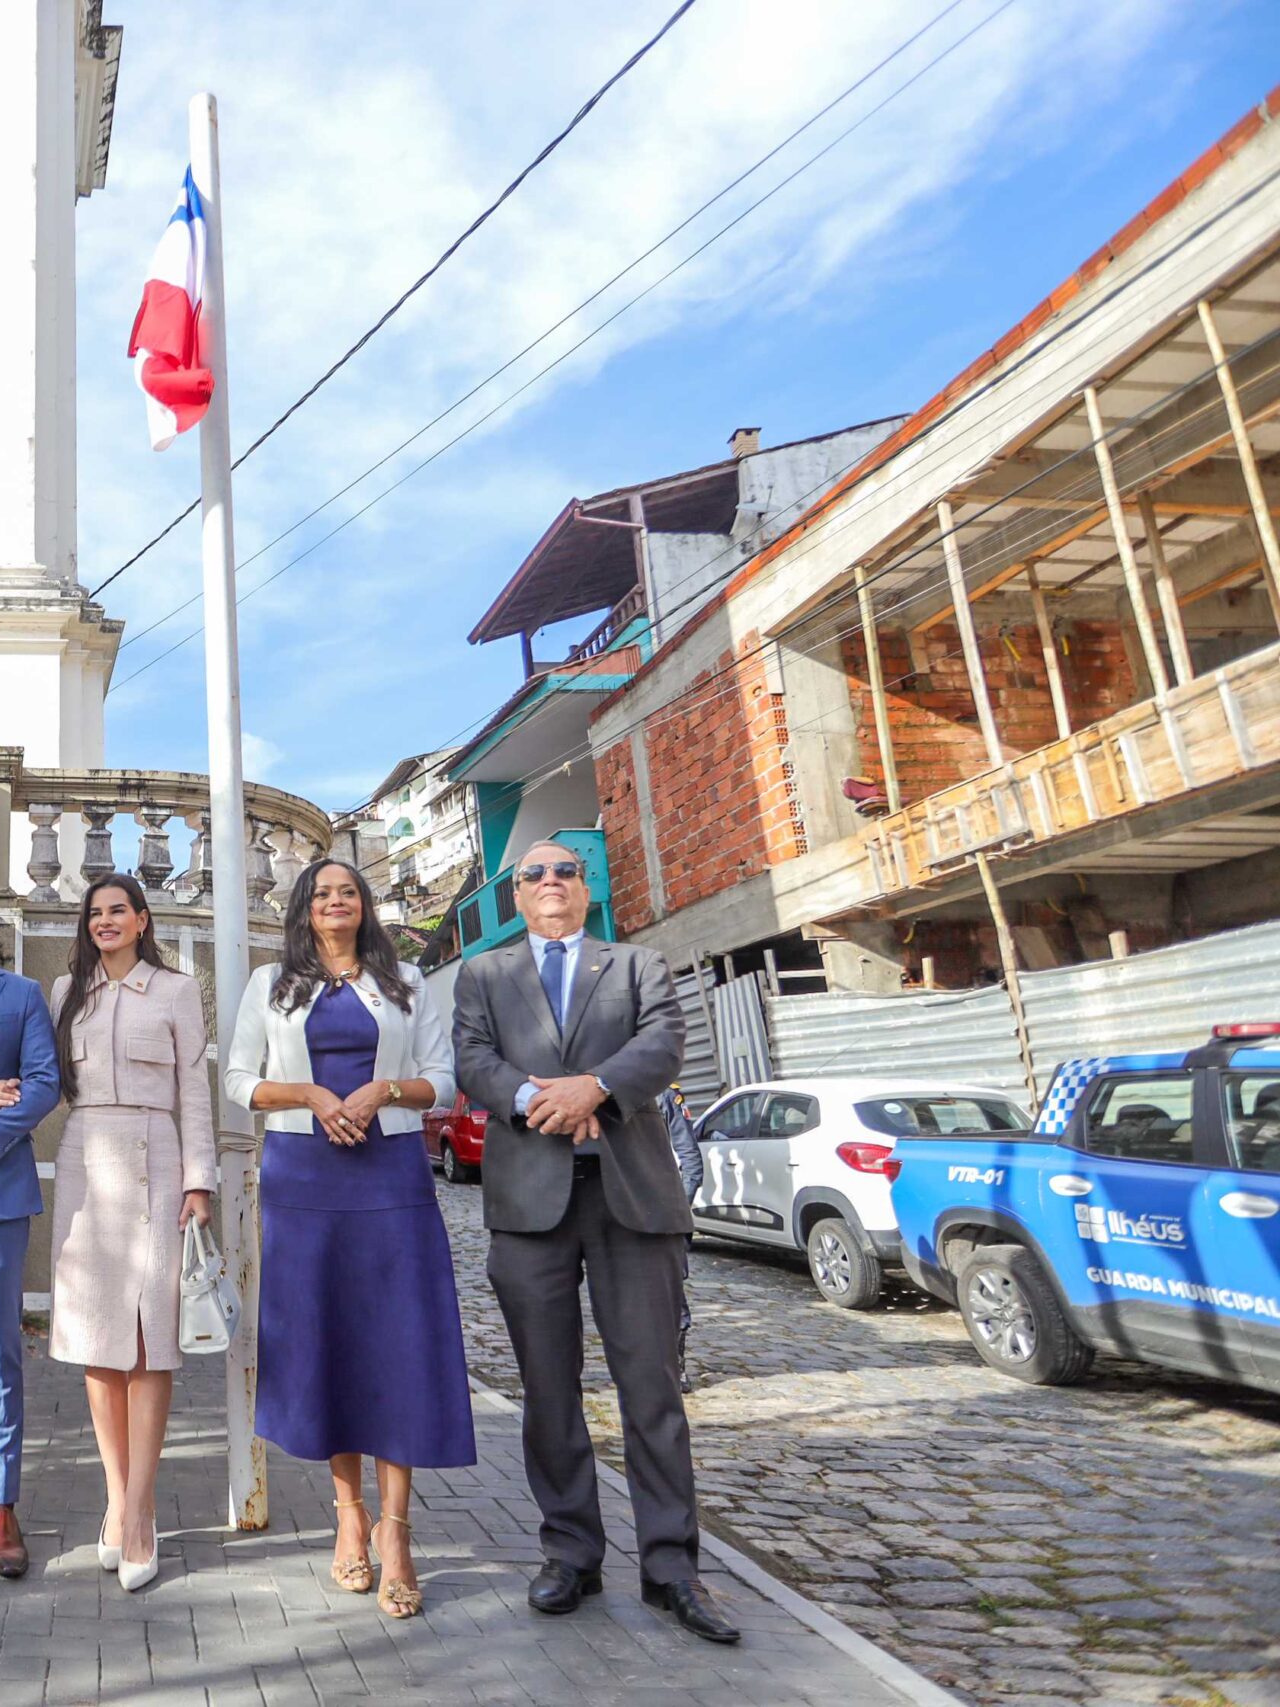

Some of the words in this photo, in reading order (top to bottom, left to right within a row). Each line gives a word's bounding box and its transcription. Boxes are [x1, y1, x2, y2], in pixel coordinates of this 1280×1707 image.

[948, 1166, 1005, 1186] VTR-01
[1107, 1210, 1185, 1242] Ilhéus
[1086, 1266, 1167, 1295] GUARDA
[1168, 1279, 1280, 1319] MUNICIPAL
